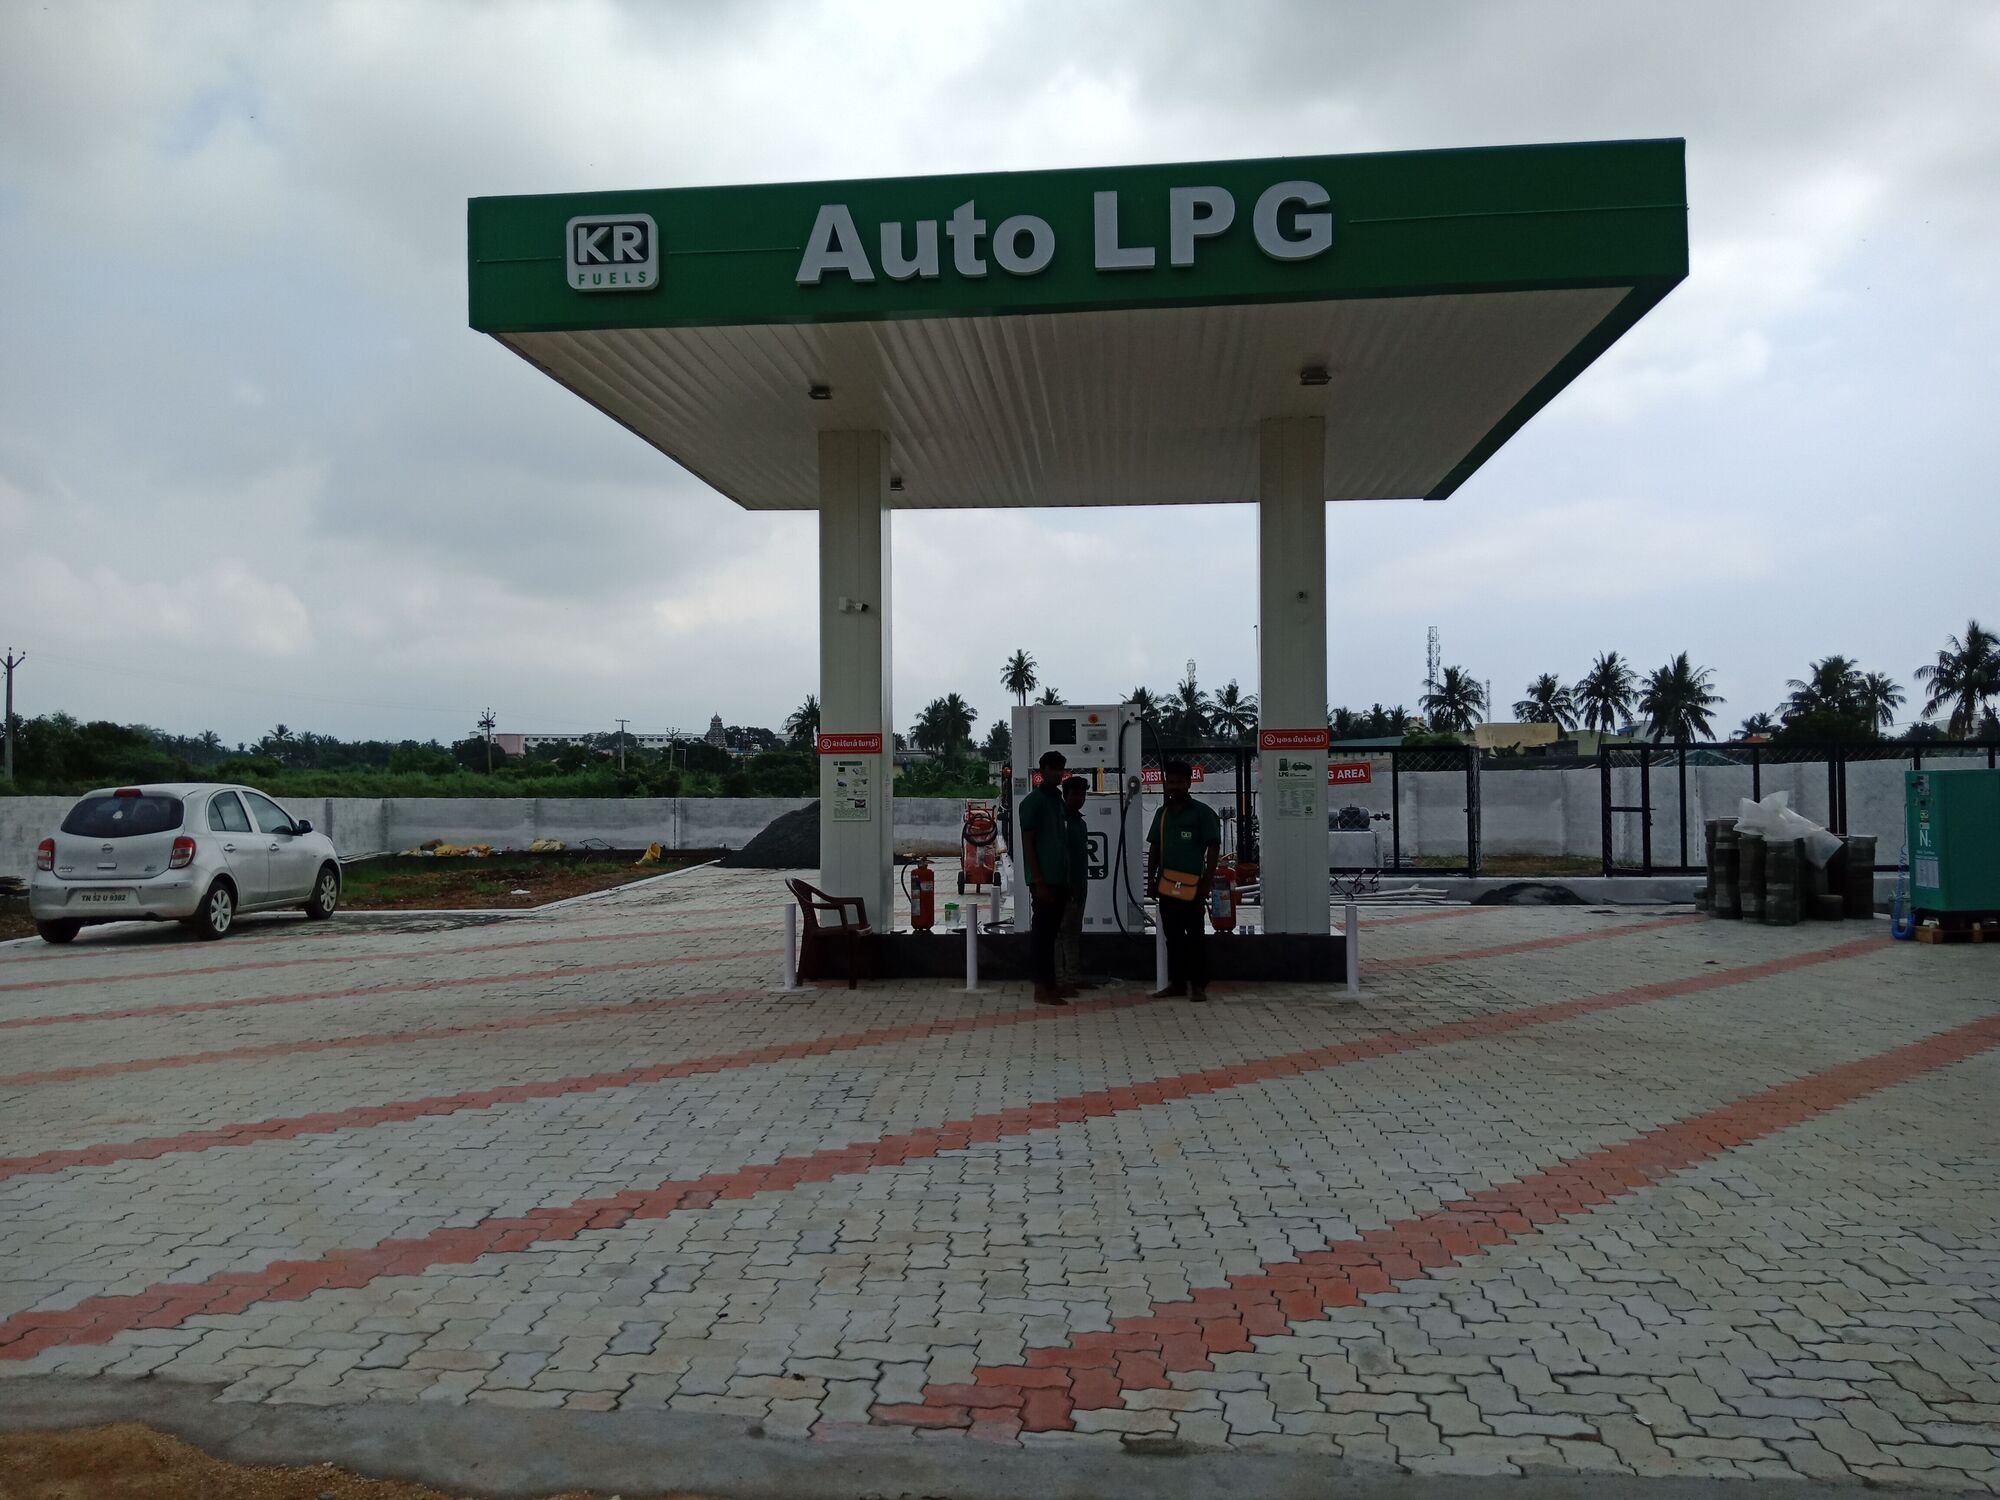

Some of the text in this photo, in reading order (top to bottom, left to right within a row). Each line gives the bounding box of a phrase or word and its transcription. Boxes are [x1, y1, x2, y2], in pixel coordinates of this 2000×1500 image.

[577, 225, 644, 262] KR
[795, 180, 1333, 284] Auto LPG
[578, 271, 647, 286] FUELS
[1337, 768, 1366, 779] AREA
